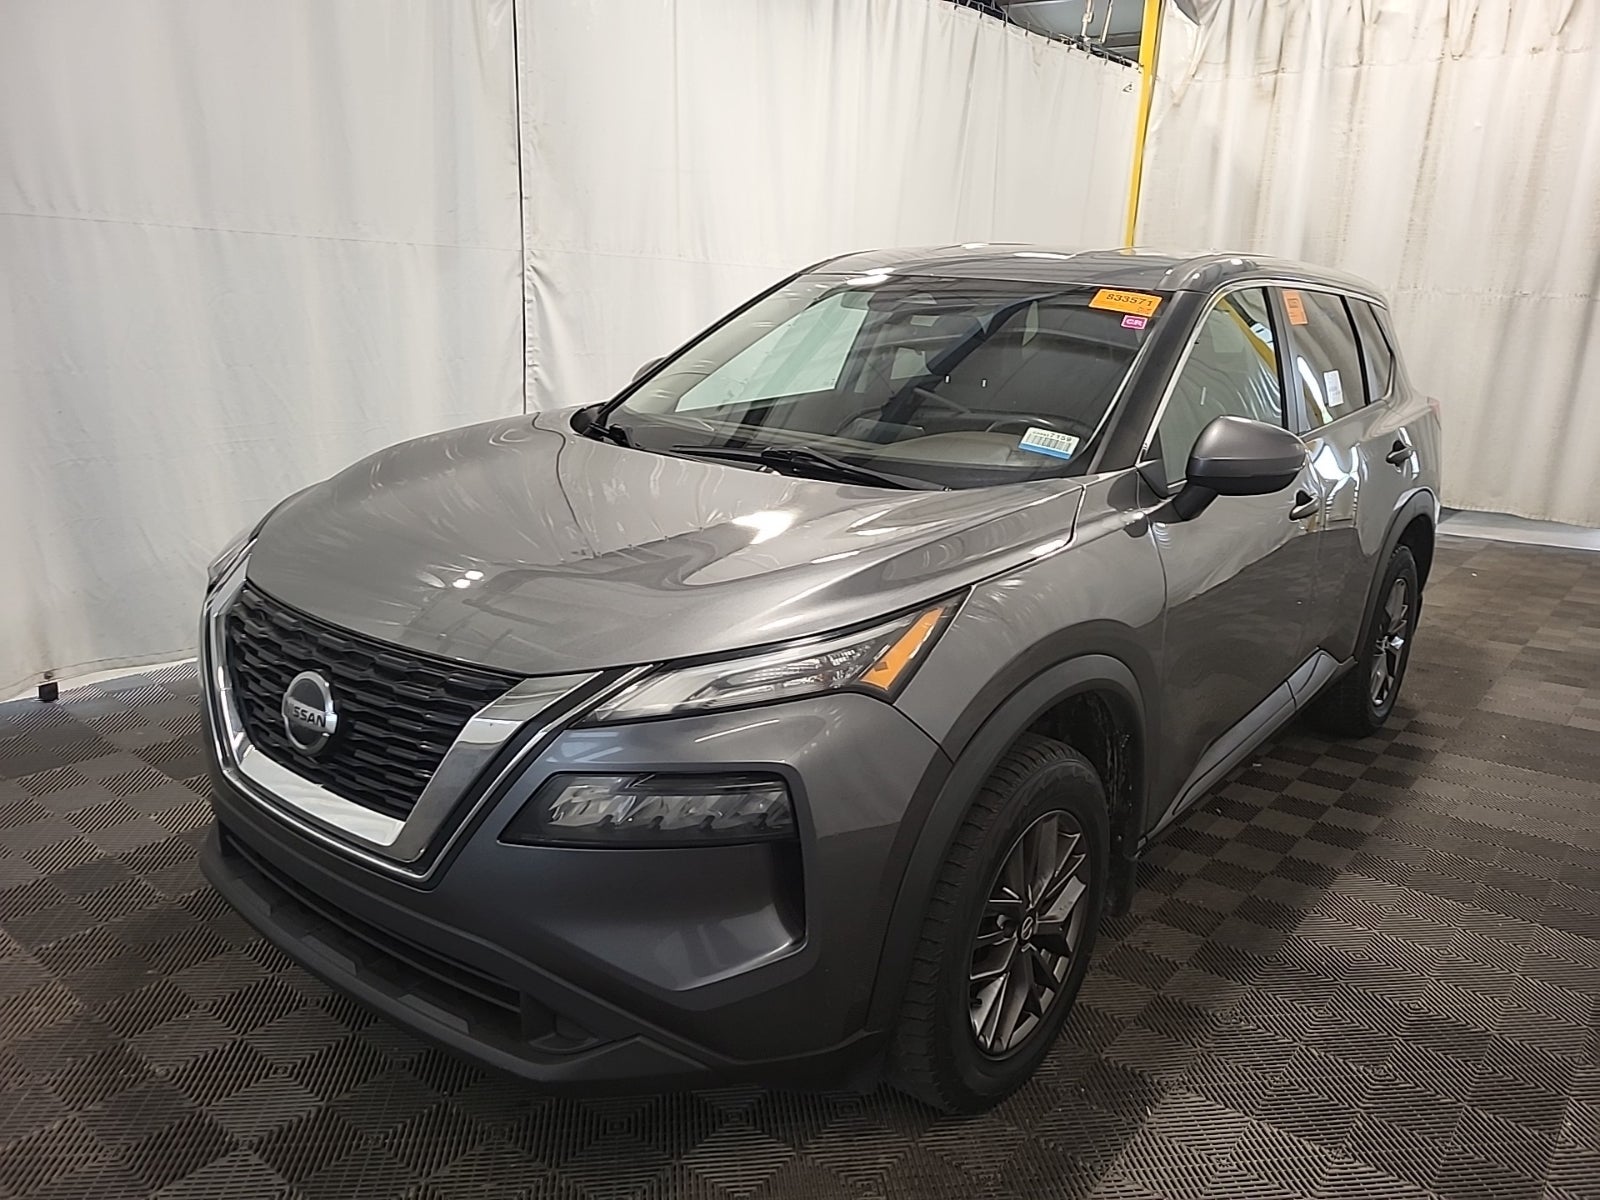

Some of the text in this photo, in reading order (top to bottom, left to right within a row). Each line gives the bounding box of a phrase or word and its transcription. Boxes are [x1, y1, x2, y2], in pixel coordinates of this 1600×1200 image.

[1106, 293, 1153, 307] 833571
[1125, 318, 1143, 327] CR
[287, 702, 326, 728] SSAN
